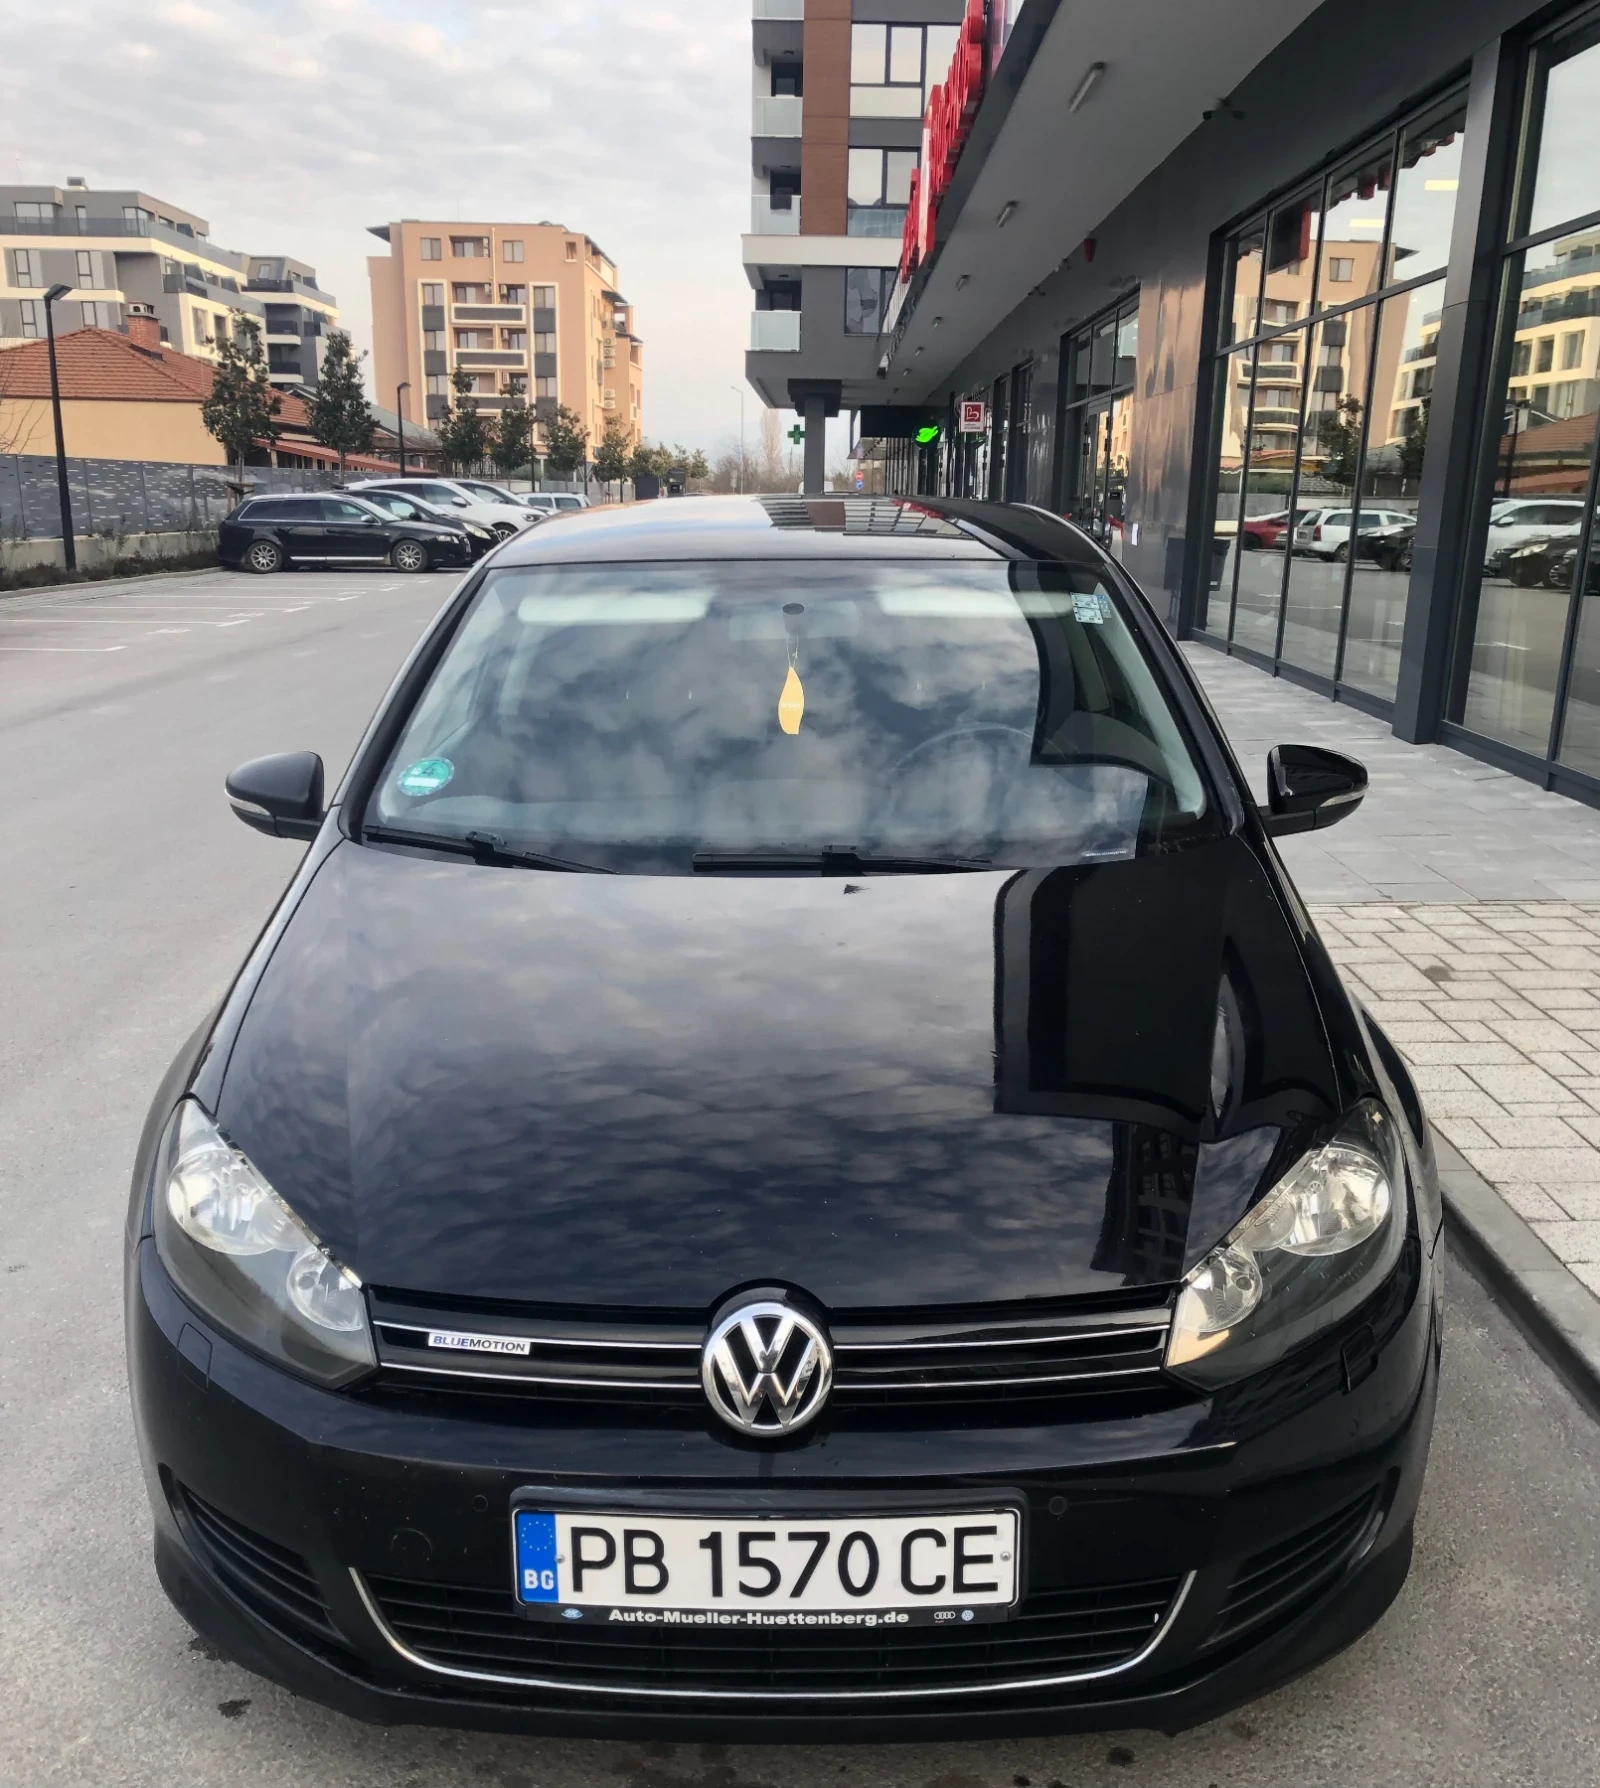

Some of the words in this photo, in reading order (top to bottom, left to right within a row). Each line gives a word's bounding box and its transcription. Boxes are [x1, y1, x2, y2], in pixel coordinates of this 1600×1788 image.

[433, 1335, 526, 1352] BLUEMOTION
[709, 1309, 827, 1429] VW
[571, 1526, 669, 1594] PB
[699, 1531, 879, 1598] 1570
[900, 1525, 998, 1595] CE
[524, 1569, 554, 1590] BG
[608, 1609, 909, 1627] Auto-Mueller-Huettenberg.de
